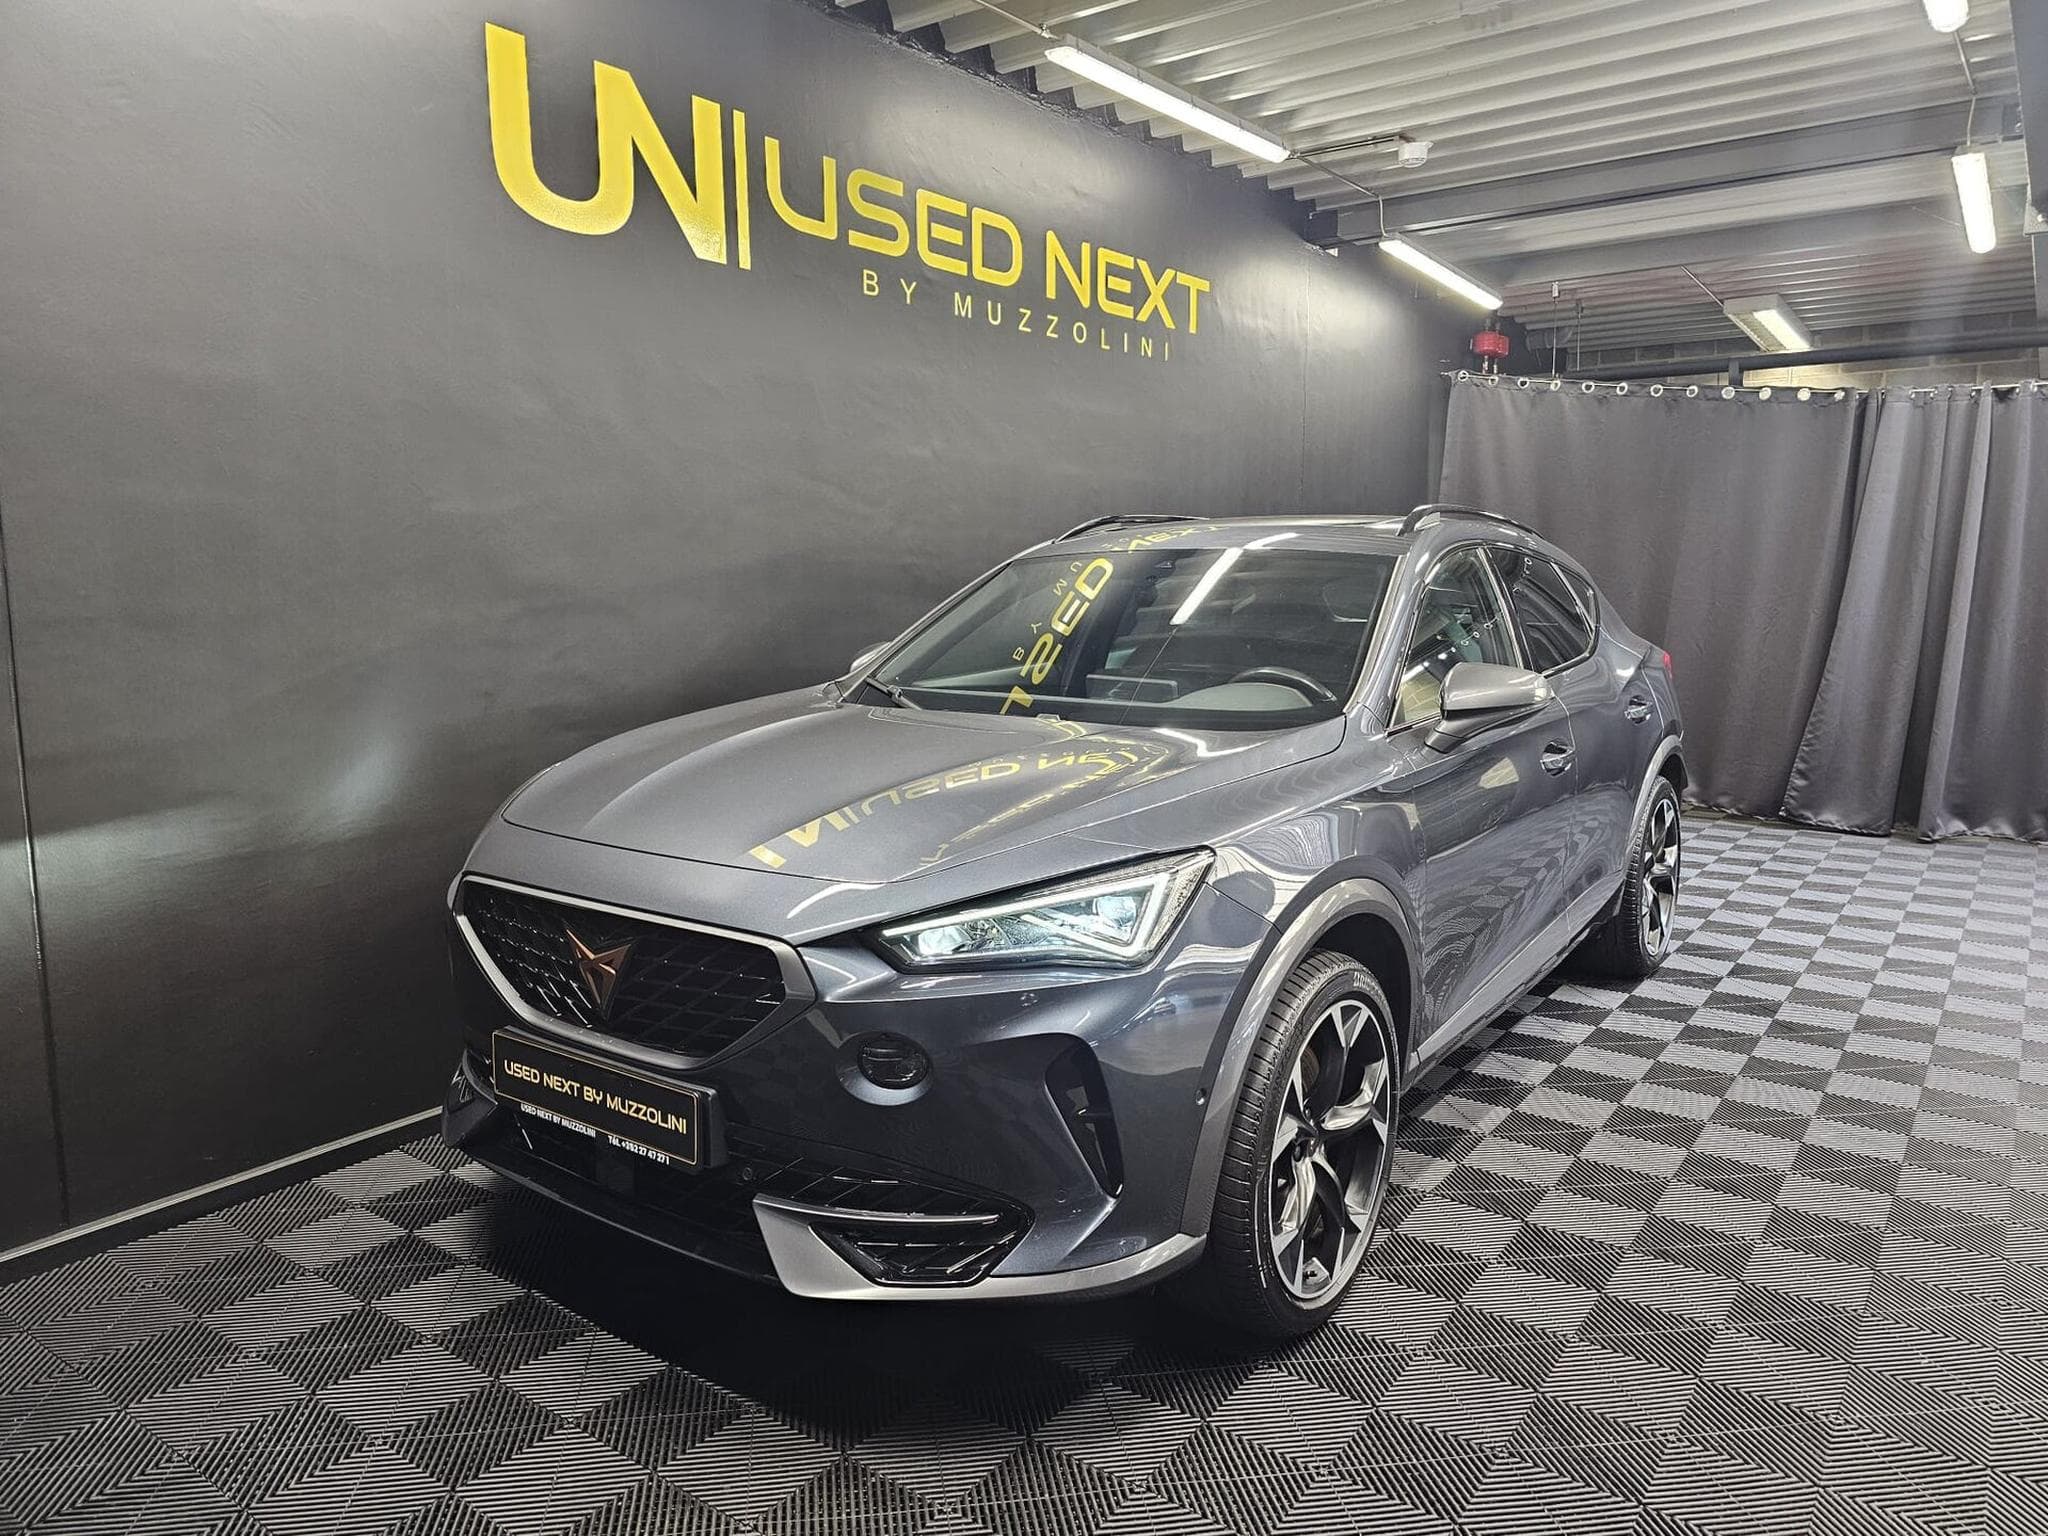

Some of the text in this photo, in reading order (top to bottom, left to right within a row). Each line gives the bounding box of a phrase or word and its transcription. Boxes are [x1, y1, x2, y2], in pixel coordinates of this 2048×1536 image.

[764, 136, 1210, 334] USED NEXT
[862, 269, 1171, 362] BY MUZZOLINI
[504, 1059, 687, 1134] USED NEXT BY MUZZOLINI
[521, 1103, 597, 1138] USED NEXT BY MUZZOLINI
